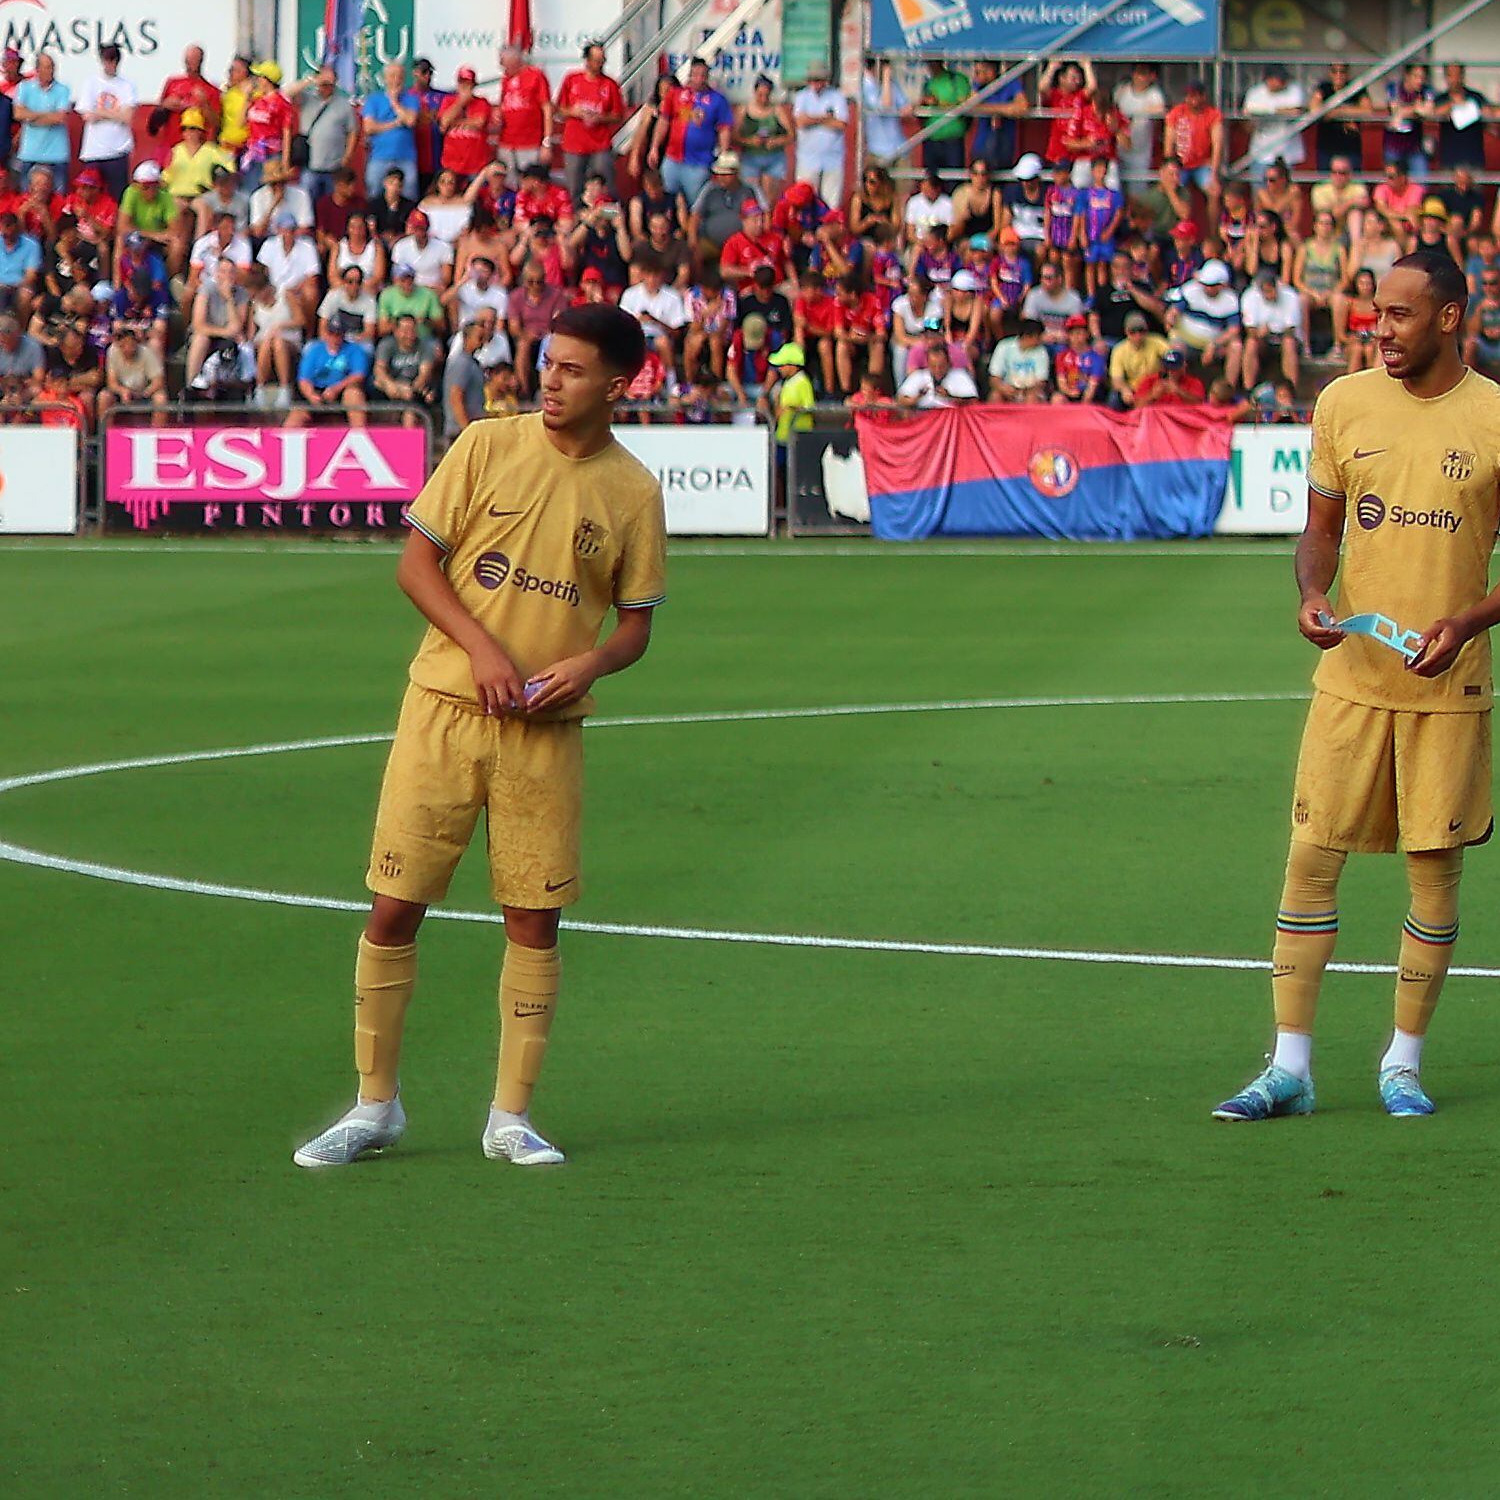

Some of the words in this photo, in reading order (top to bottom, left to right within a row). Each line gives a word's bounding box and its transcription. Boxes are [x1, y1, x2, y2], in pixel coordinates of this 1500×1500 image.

[5, 17, 159, 54] MASIAS
[120, 427, 411, 500] ESJA
[1389, 505, 1463, 533] Spotify
[513, 569, 581, 608] Spotify
